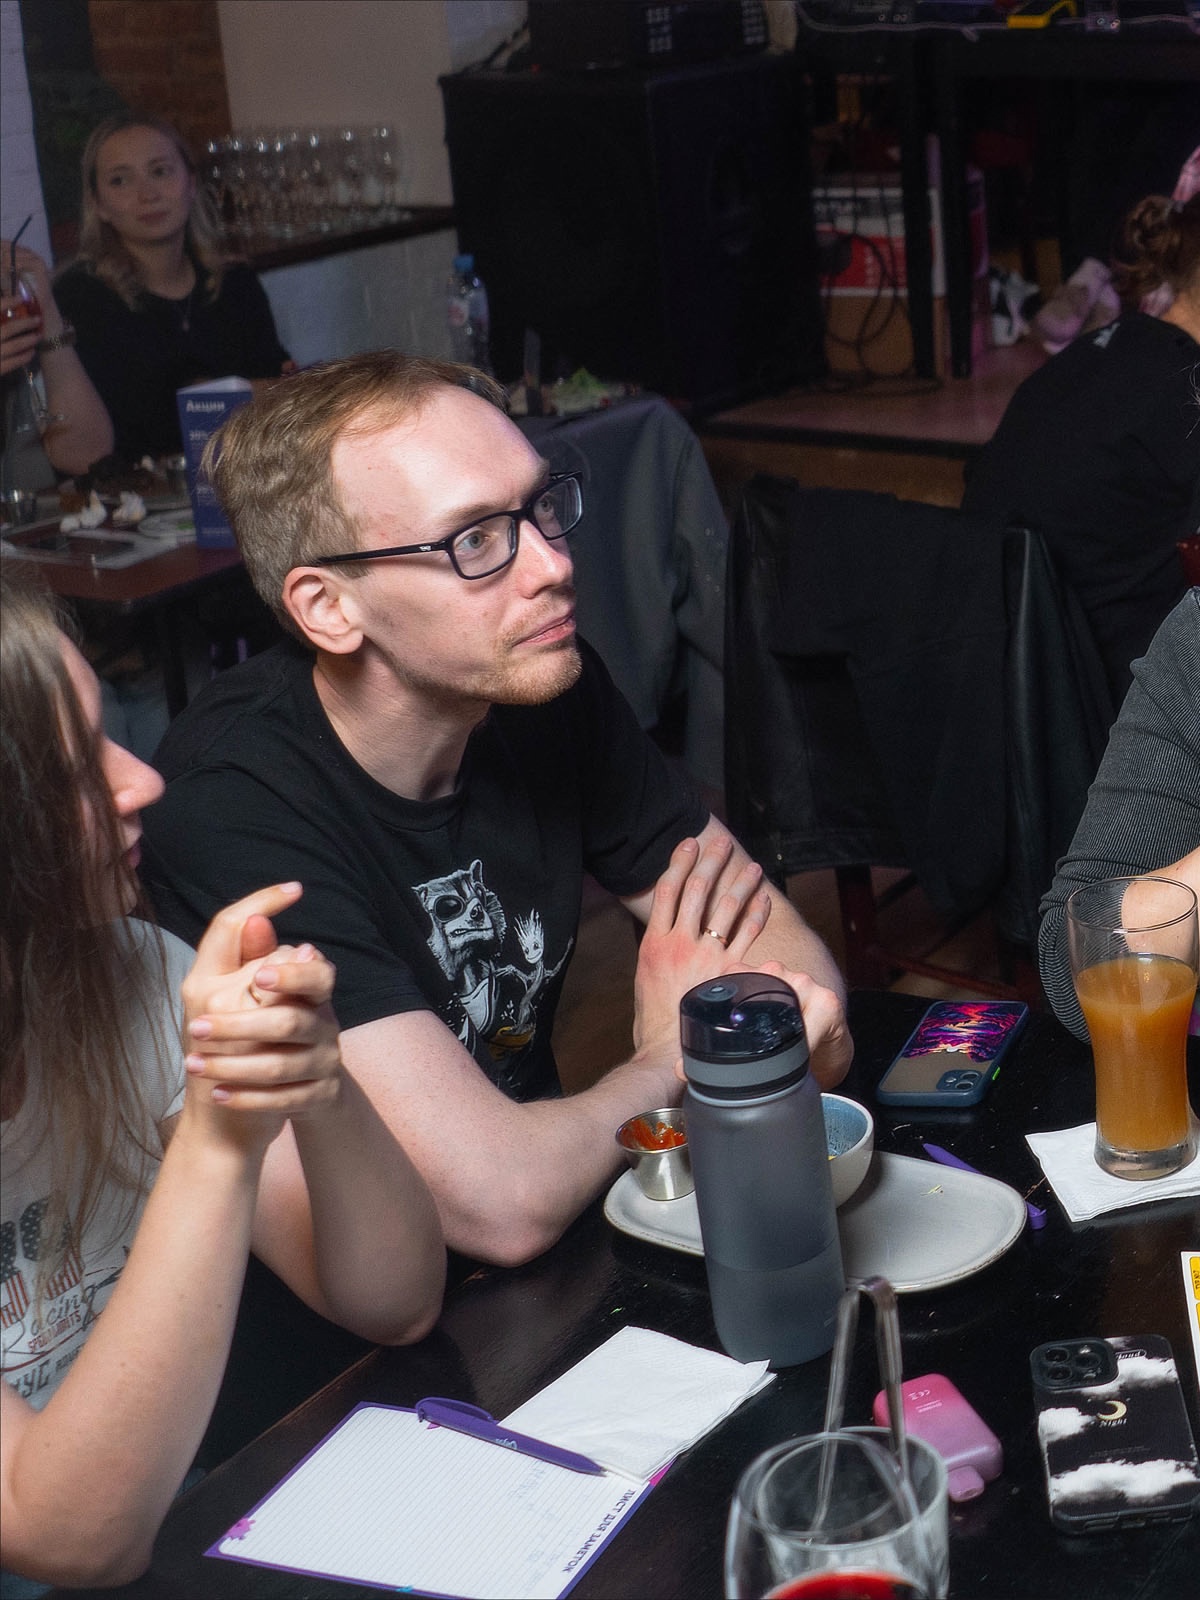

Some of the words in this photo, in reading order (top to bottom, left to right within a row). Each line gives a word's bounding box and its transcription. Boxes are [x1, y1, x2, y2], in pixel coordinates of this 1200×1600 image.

[186, 400, 225, 413] Акции
[613, 1489, 636, 1513] ЛИСТ
[597, 1514, 616, 1532] ДЛЯ
[562, 1533, 600, 1573] ЗАМЕТОК
